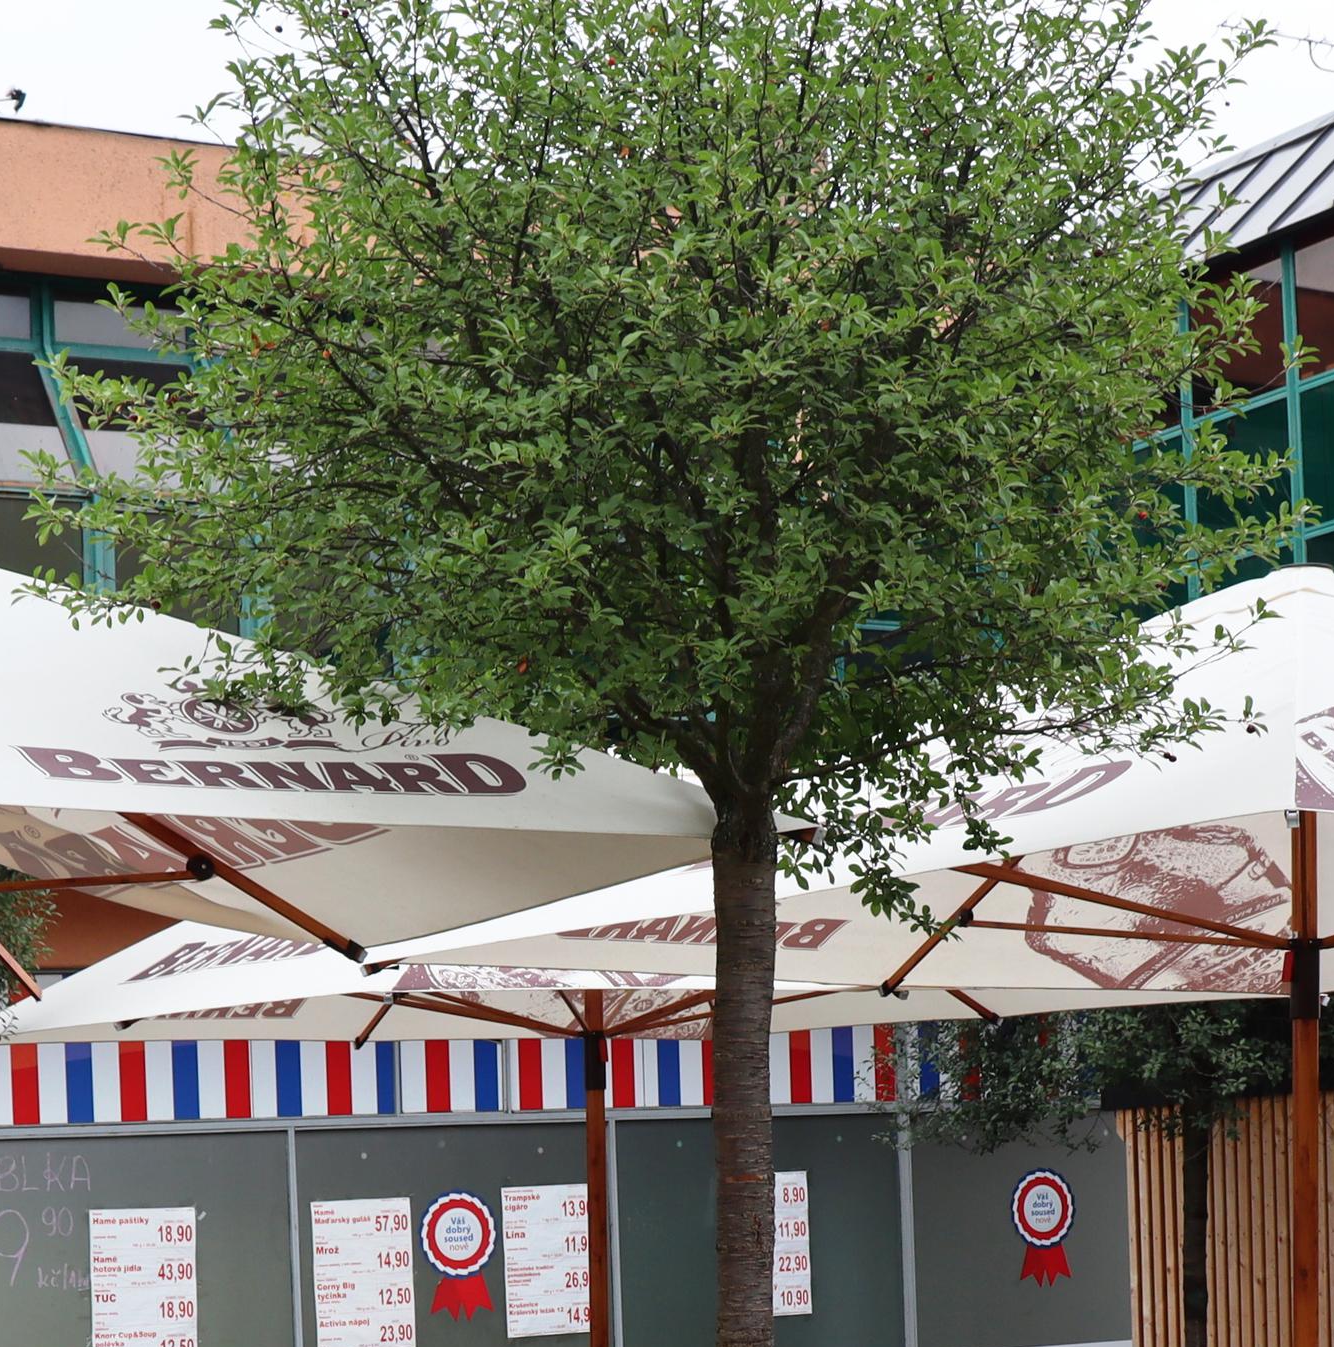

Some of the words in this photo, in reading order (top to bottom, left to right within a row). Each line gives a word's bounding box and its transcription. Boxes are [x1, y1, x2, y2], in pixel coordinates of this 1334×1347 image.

[8, 745, 527, 796] BERNARD
[783, 1186, 805, 1205] 8,90
[562, 1199, 588, 1219] 13,9
[42, 1206, 74, 1237] 90
[119, 1216, 149, 1226] paštiky
[375, 1214, 408, 1234] 57,90
[446, 1224, 472, 1235] dobrý
[450, 1216, 465, 1225] Váš
[779, 1221, 806, 1239] 11,90
[157, 1225, 193, 1245] 18,90
[444, 1233, 474, 1243] soused
[316, 1246, 340, 1255] Mrož
[565, 1235, 588, 1255] 11,9
[377, 1250, 409, 1271] 14,90
[779, 1255, 807, 1273] 22,90
[158, 1263, 193, 1283] 43,90
[565, 1271, 589, 1290] 26,9
[95, 1294, 117, 1303] TUC
[379, 1287, 411, 1307] 12,50
[780, 1289, 809, 1308] 10,90
[159, 1301, 194, 1320] 18,90
[567, 1307, 591, 1325] 14,9
[319, 1320, 347, 1328] Activia
[380, 1324, 412, 1344] 23,90
